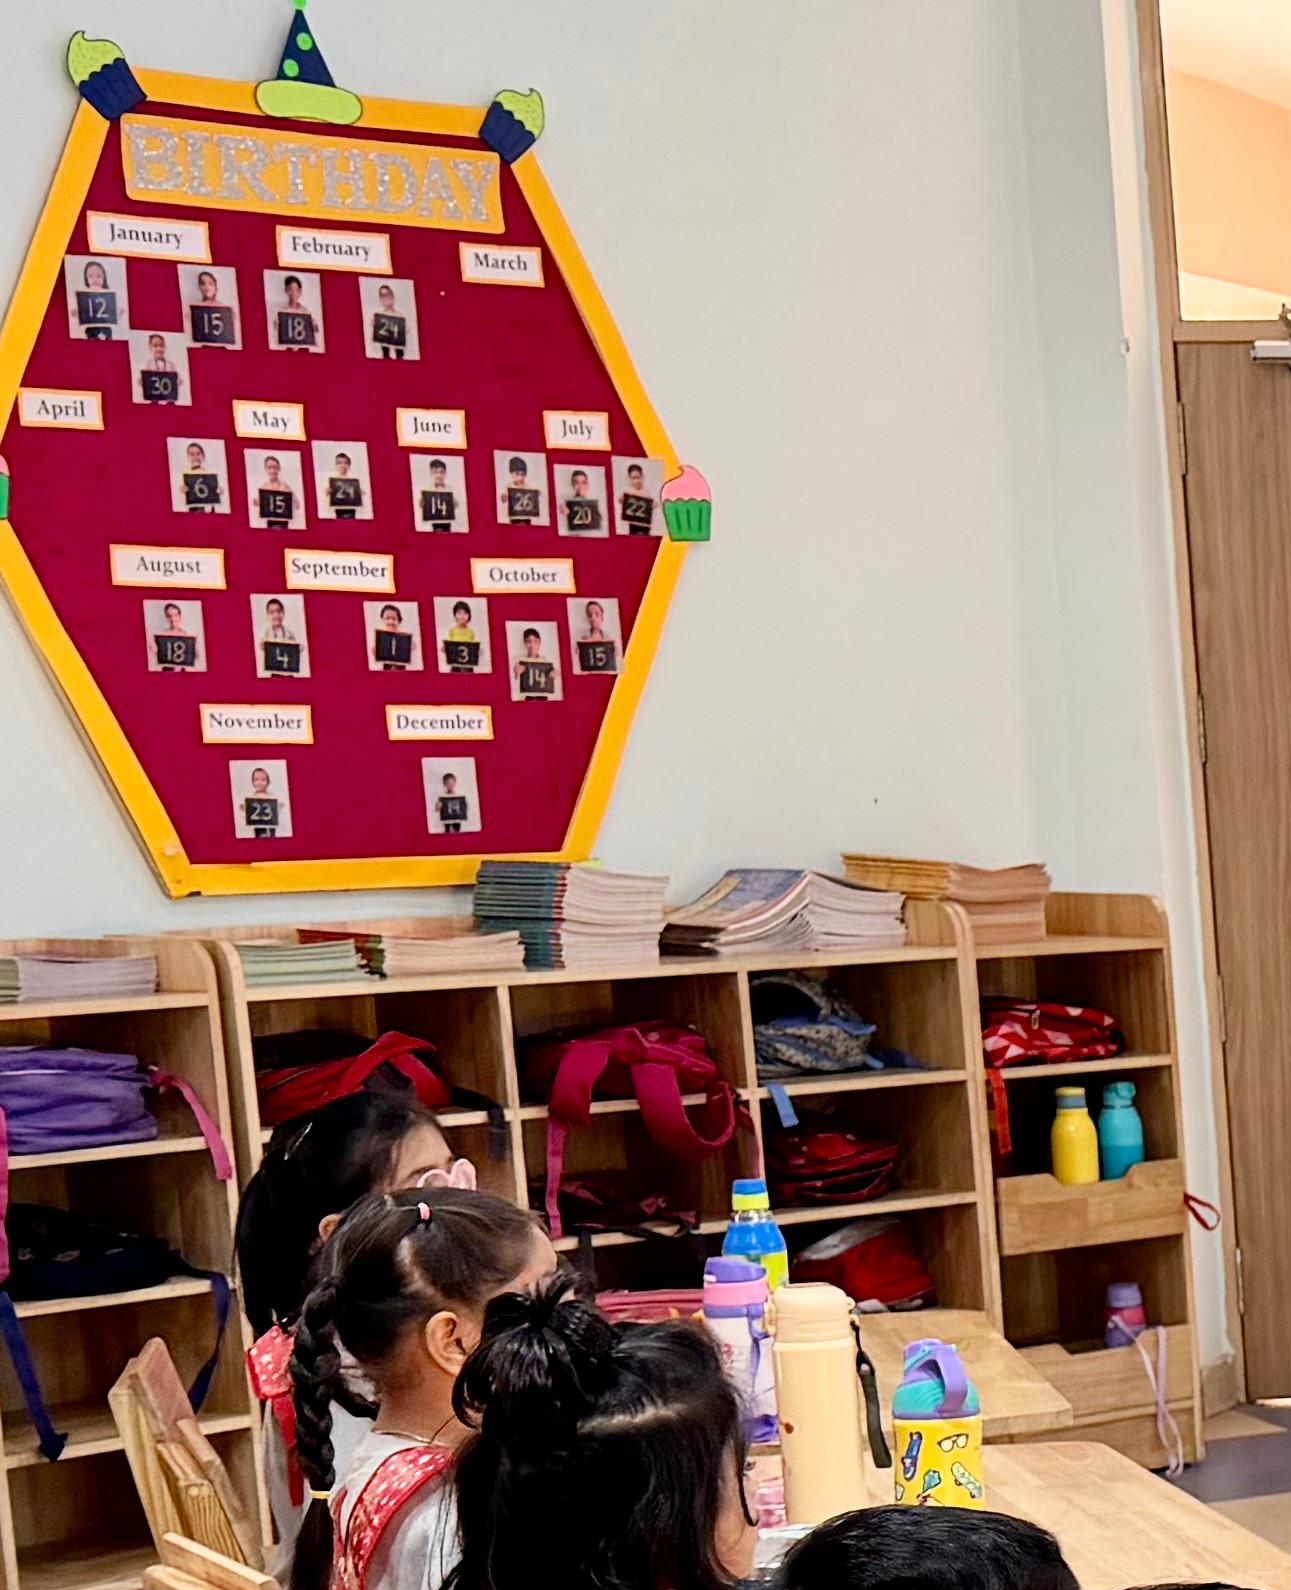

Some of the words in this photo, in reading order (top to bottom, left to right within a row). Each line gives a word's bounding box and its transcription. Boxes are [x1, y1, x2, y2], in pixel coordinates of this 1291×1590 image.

[125, 123, 498, 221] BIRTHDAY
[109, 222, 183, 248] January
[291, 235, 371, 262] February
[474, 252, 528, 272] March
[87, 298, 109, 318] 12
[203, 312, 222, 335] 15
[287, 316, 305, 341] 18
[377, 317, 400, 338] 24
[150, 376, 172, 396] 30
[36, 400, 86, 422] April
[251, 410, 290, 430] May
[413, 416, 452, 435] June
[561, 419, 594, 440] July
[194, 479, 208, 498] 6
[335, 482, 356, 499] 24
[268, 496, 285, 514] 15
[430, 496, 447, 517] 14
[513, 492, 534, 512] 26
[626, 500, 648, 518] 22
[571, 506, 593, 526] 20
[136, 555, 202, 577] August
[291, 557, 389, 579] September
[488, 566, 558, 583] October
[166, 641, 186, 664] 18
[275, 649, 290, 670] 4
[457, 644, 470, 664] 3
[588, 647, 608, 667] 15
[527, 669, 547, 690] 14
[208, 712, 304, 730] November
[395, 713, 485, 731] December
[250, 803, 273, 822] 23
